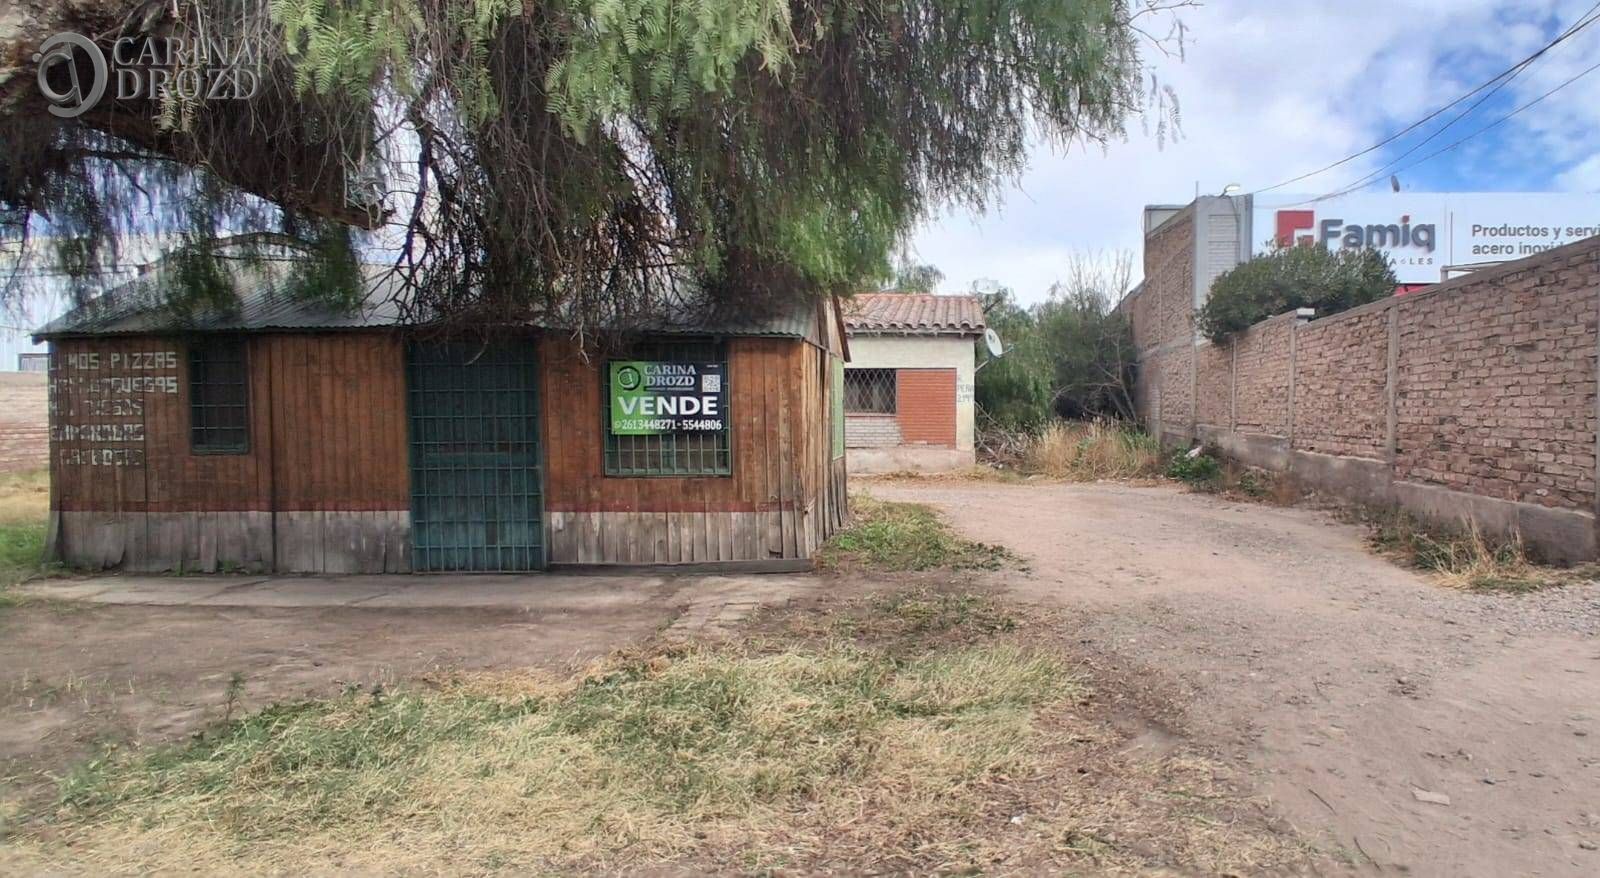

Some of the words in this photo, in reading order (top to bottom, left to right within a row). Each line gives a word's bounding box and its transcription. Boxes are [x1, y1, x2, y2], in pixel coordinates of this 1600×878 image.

[1320, 214, 1436, 254] Famiq
[1471, 223, 1549, 237] Productos
[1553, 226, 1562, 240] y
[1471, 244, 1515, 255] acero
[48, 352, 99, 371] LMOS
[111, 352, 177, 369] PIZZAS
[644, 365, 696, 375] CARINA
[647, 376, 695, 386] DROZD
[617, 396, 718, 415] VENDE
